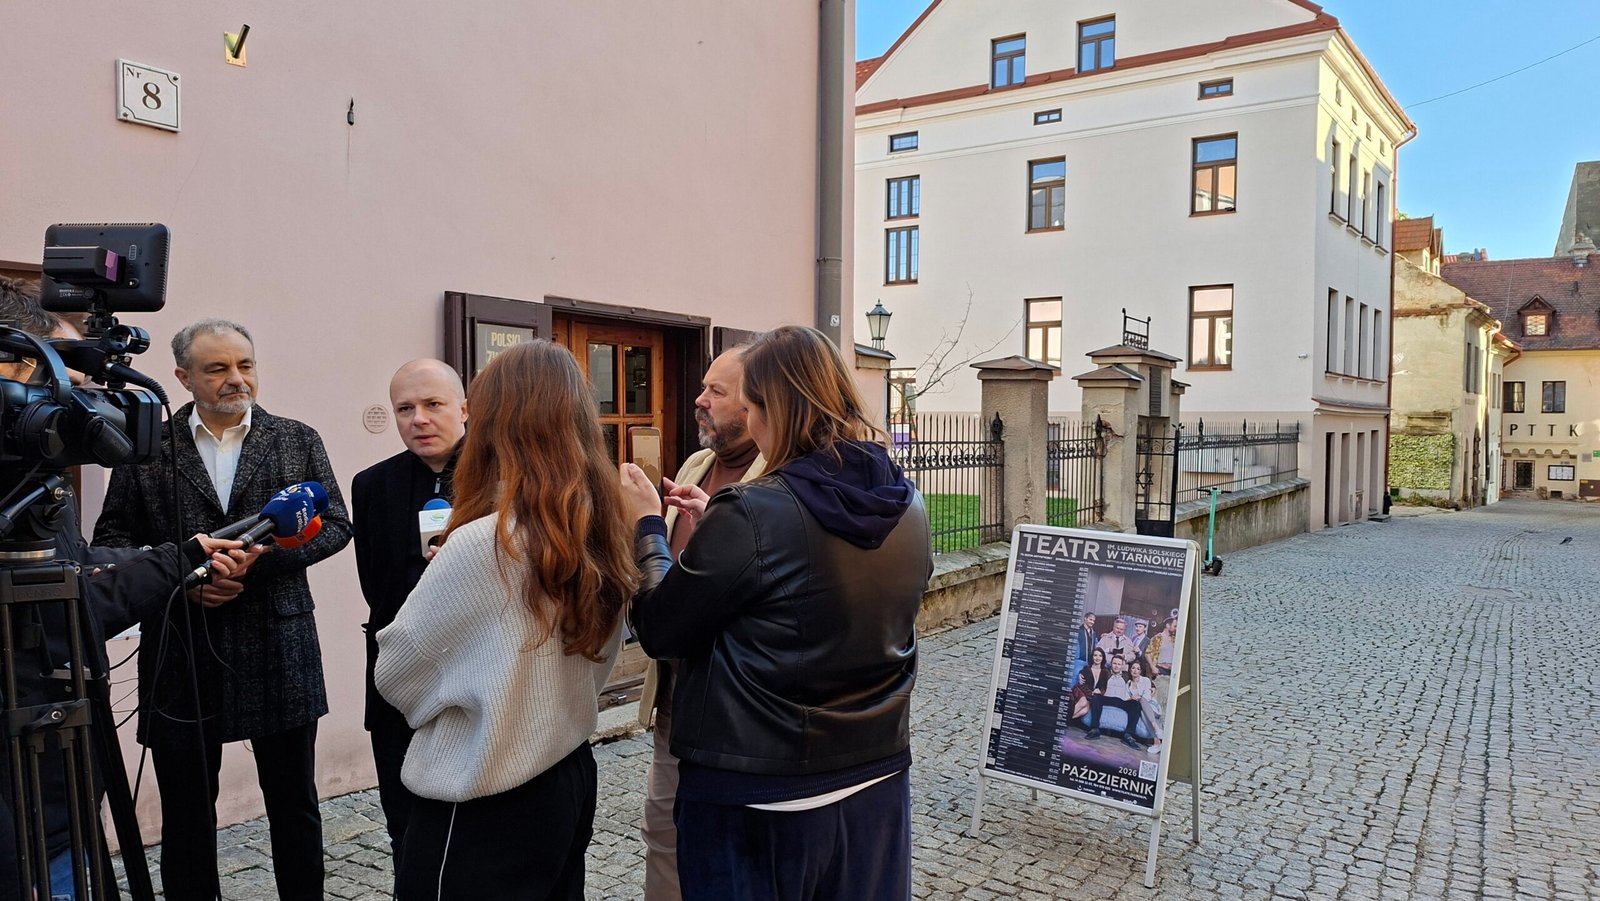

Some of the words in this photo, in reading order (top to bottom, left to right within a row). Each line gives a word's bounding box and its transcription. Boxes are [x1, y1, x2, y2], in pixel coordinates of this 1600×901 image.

[126, 67, 142, 78] Nr
[142, 82, 162, 110] 8
[1023, 533, 1100, 561] TEATR
[1117, 545, 1147, 554] LUDWIKA
[1148, 549, 1186, 559] SOLSKIEGO
[1106, 549, 1119, 560] W
[1121, 551, 1185, 569] TARNOWIE
[1061, 763, 1155, 797] PAŹDZIERNIK
[1118, 766, 1138, 777] 2026
